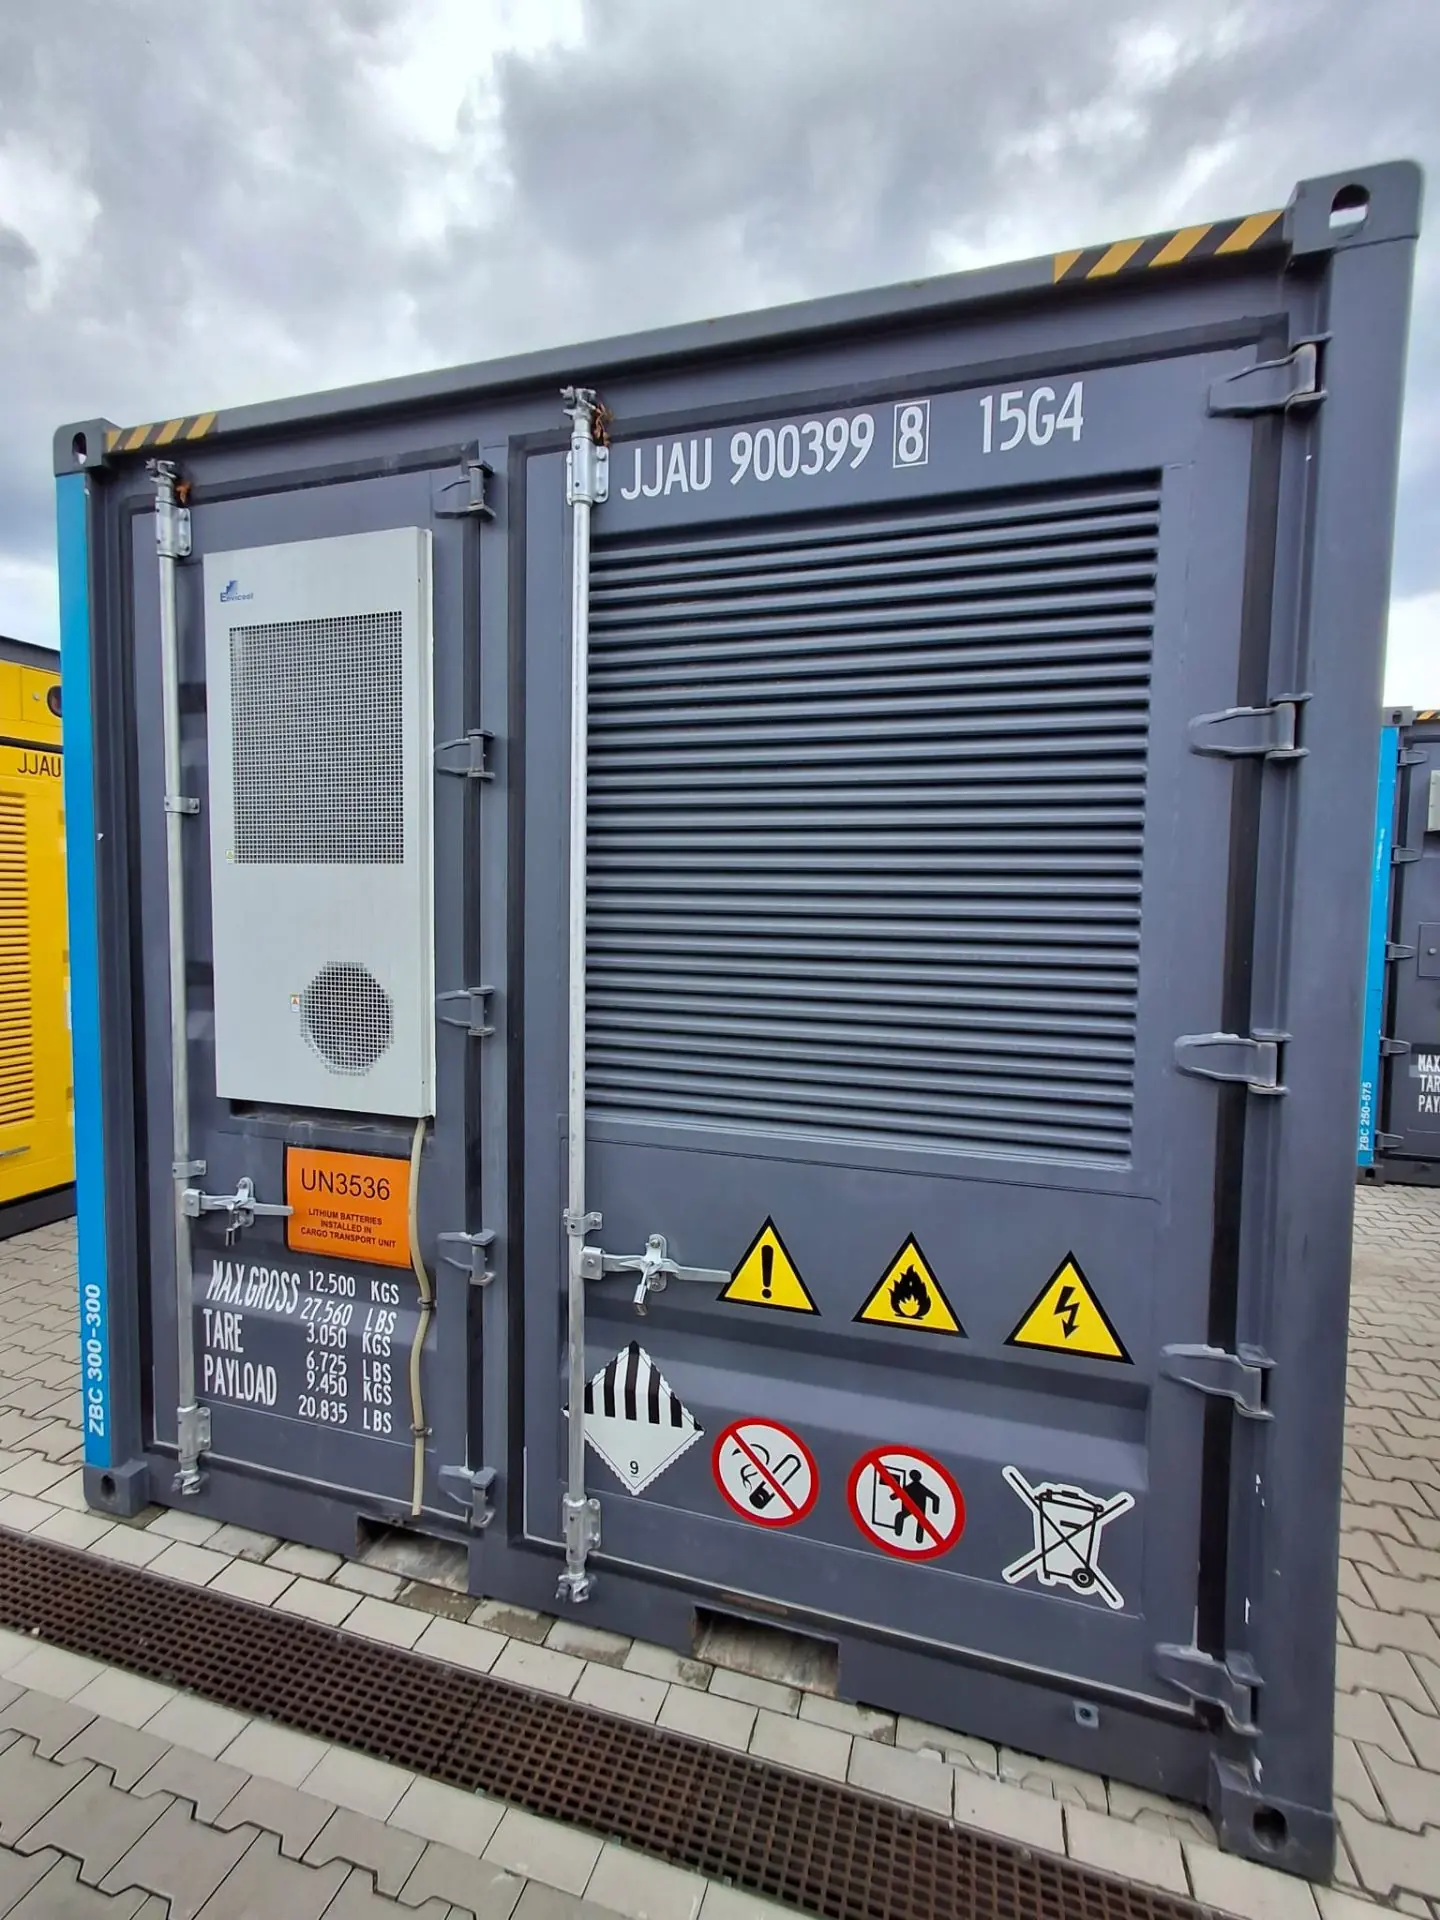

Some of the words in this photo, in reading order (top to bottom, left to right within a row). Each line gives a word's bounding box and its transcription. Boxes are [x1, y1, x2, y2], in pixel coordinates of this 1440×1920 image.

[620, 437, 713, 500] JJAU
[730, 412, 875, 486] 900399
[898, 406, 924, 463] 8
[980, 381, 1084, 454] 15G4
[16, 752, 62, 778] JJAU
[301, 1167, 390, 1201] UN3536
[308, 1208, 339, 1221] LITHIUM
[340, 1212, 383, 1226] BATTERIES
[320, 1220, 362, 1233] INSTALLED
[363, 1226, 372, 1234] IN
[300, 1226, 328, 1238] CARGO
[329, 1231, 376, 1244] TRANSPORT
[378, 1239, 397, 1248] UNIT
[206, 1259, 301, 1315] MAX.GROSS
[371, 1280, 400, 1305] KGS
[84, 1283, 103, 1383] 300-300
[203, 1308, 244, 1353] TARE
[362, 1332, 391, 1358] KGS
[364, 1308, 397, 1335] LBS
[204, 1354, 278, 1406] PAYLOAD
[363, 1381, 392, 1406] KGS
[362, 1359, 392, 1384] LBS
[88, 1386, 105, 1437] ZBC
[363, 1407, 392, 1434] LBS
[630, 1460, 639, 1475] 9
